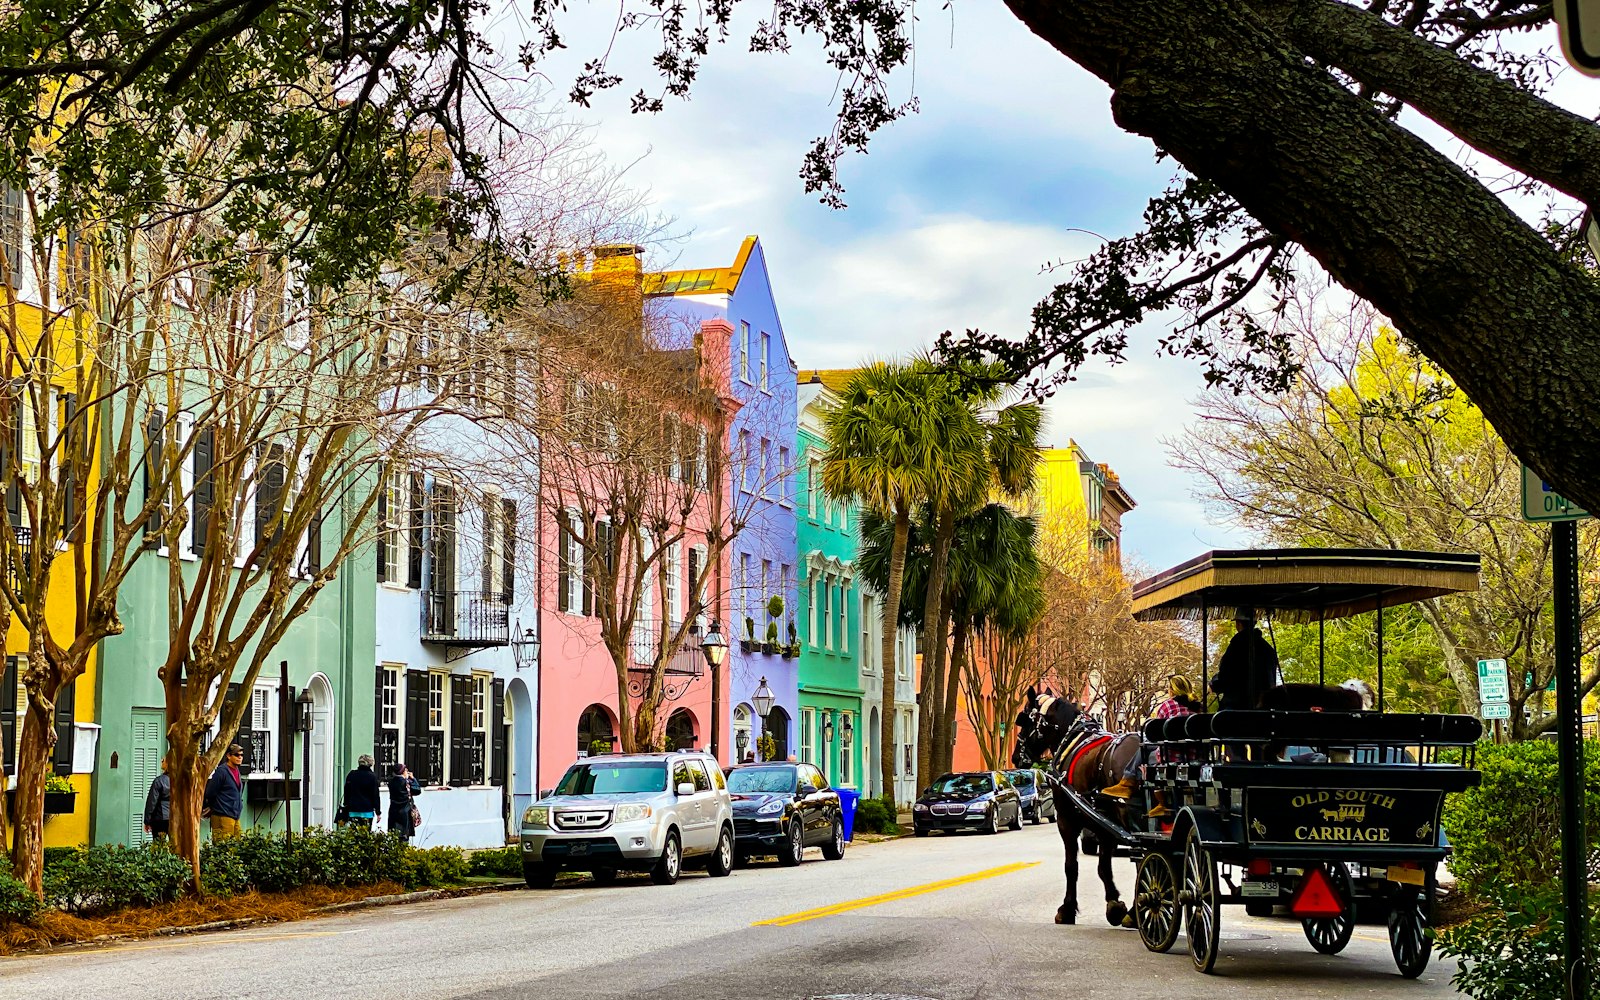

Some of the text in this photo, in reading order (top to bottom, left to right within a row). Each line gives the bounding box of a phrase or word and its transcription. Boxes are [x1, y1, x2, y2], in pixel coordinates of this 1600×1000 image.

[1544, 495, 1580, 512] ONL
[1291, 789, 1397, 810] OLD SOUTH
[1294, 826, 1390, 842] CARRIAGE
